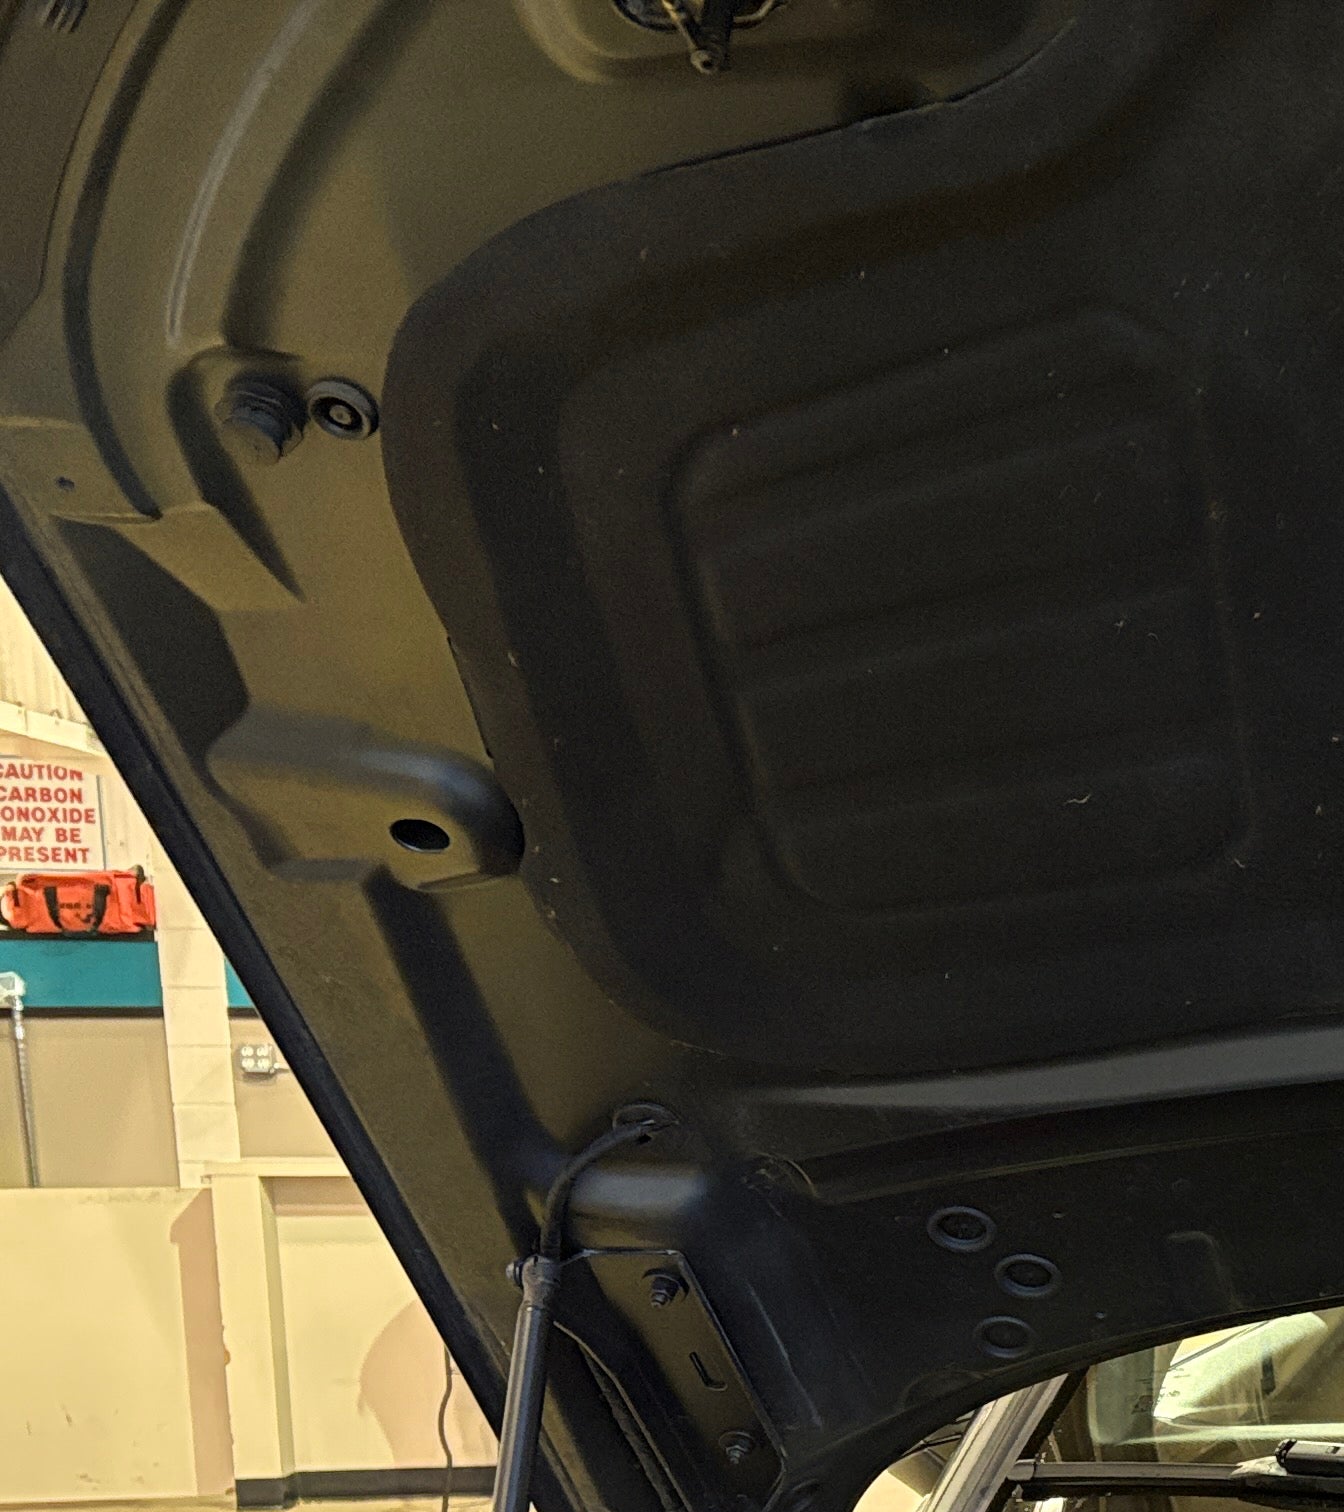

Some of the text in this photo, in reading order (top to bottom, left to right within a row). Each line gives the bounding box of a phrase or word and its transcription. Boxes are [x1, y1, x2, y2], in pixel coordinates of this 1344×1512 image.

[0, 806, 96, 824] ONOXIDE
[1, 826, 81, 844] MAY BE
[0, 846, 90, 864] PRESENT
